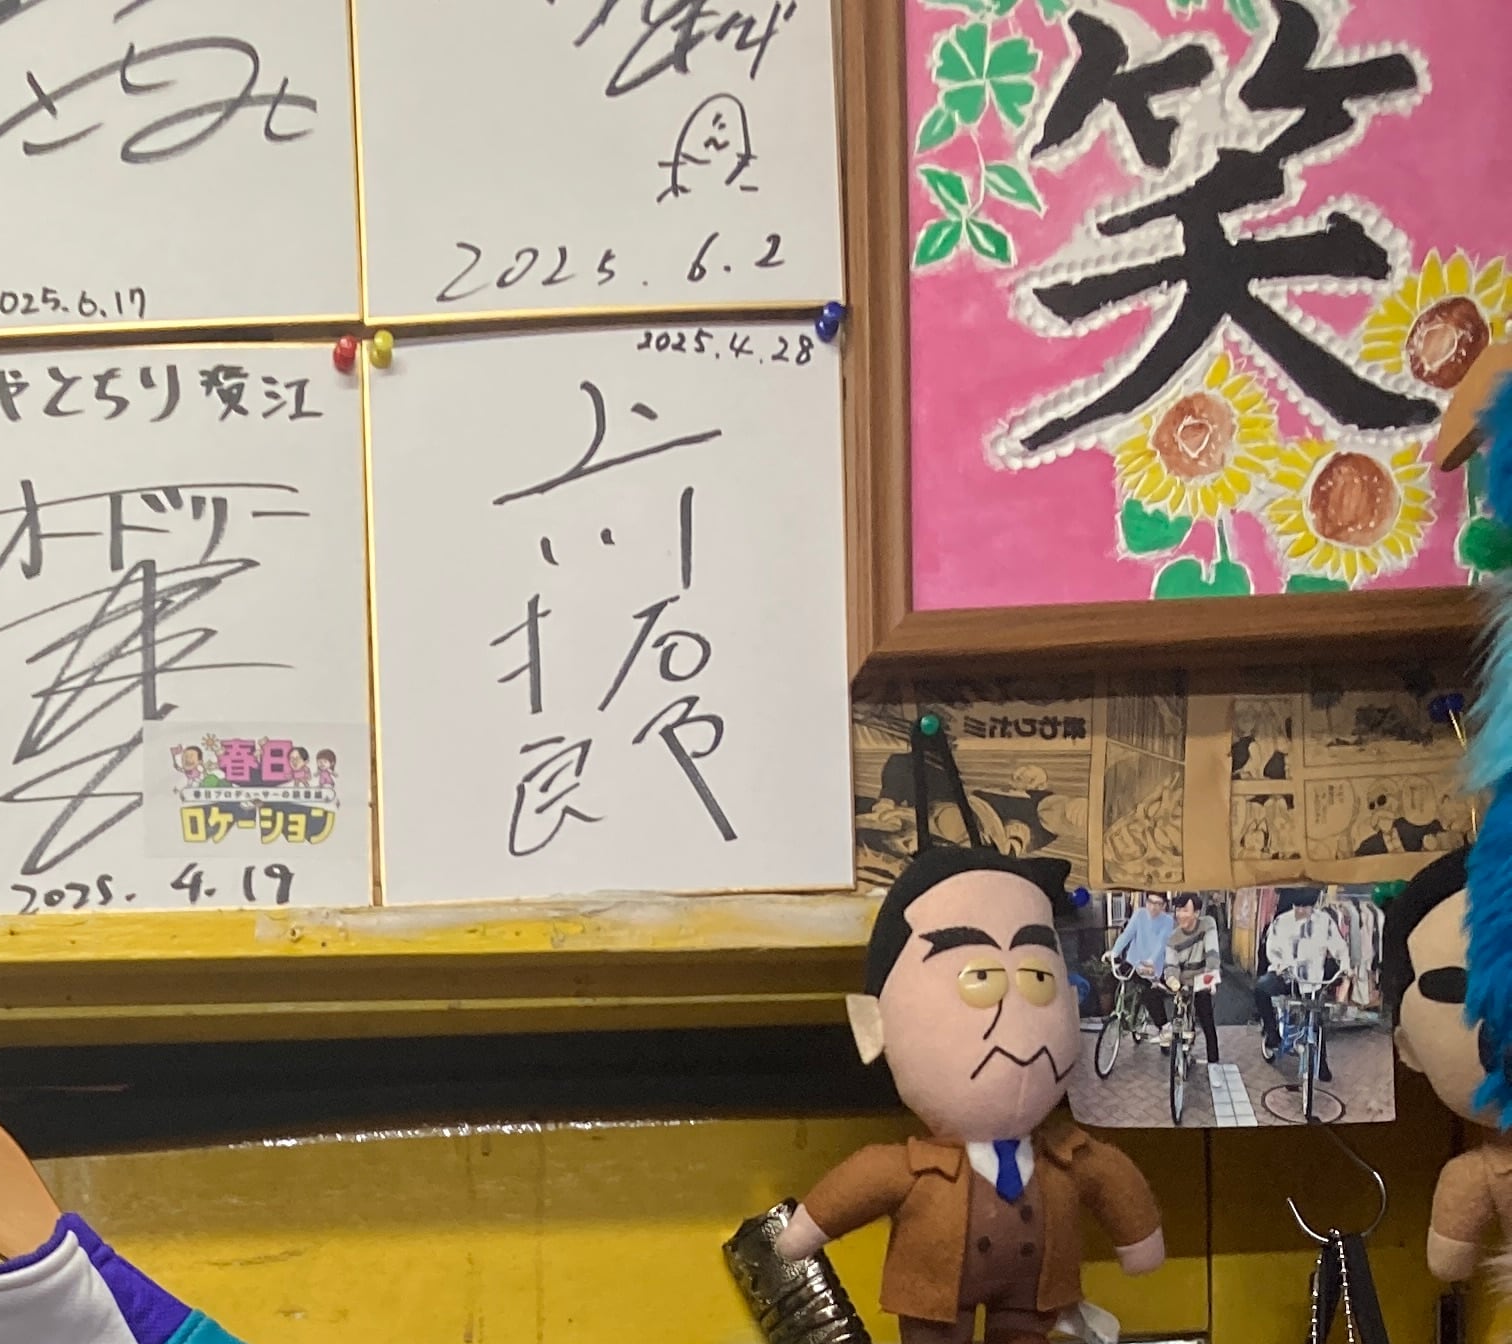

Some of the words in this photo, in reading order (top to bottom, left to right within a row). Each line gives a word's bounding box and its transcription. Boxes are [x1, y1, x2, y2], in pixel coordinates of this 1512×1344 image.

[1018, 0, 1441, 451] 笑
[637, 328, 815, 365] 2025.4.28
[218, 738, 293, 781] 春日
[180, 806, 335, 844] ロケーション
